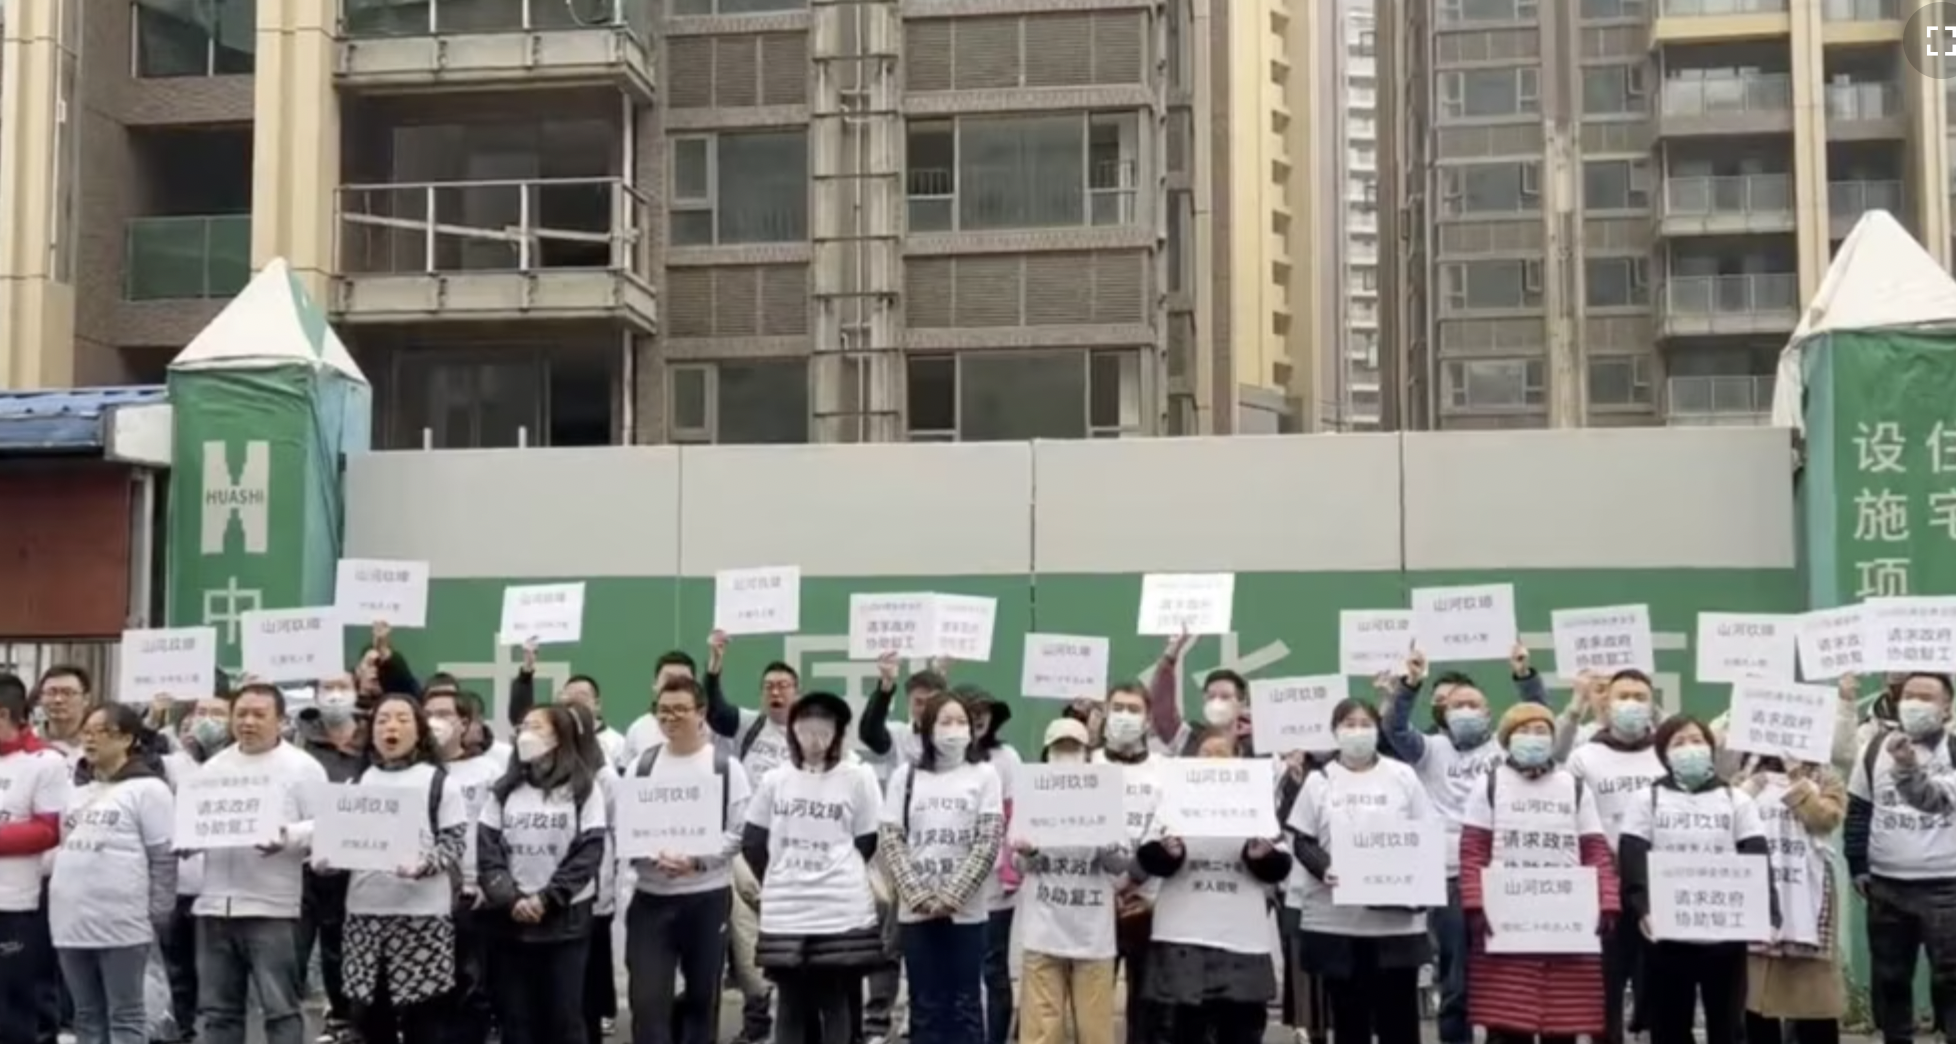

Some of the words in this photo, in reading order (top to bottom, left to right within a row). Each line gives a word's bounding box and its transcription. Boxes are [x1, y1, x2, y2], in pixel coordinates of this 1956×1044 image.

[206, 489, 265, 505] HUASHI
[1433, 595, 1493, 612] 山河玖璋
[261, 617, 321, 634] 山河玖璋
[1357, 618, 1410, 632] 山河玖璋
[1717, 622, 1776, 637] 山河玖璋
[1574, 634, 1631, 651] 请求政府
[1816, 634, 1861, 652] 请求政
[1886, 627, 1952, 642] 请求政府
[1575, 651, 1632, 667] 协助复工
[1820, 651, 1864, 669] 协助复
[1886, 646, 1952, 661] 协助复工
[1270, 686, 1327, 703] 山河玖璋
[1751, 709, 1814, 730] 请求政府
[1749, 727, 1810, 749] 协助复工
[1033, 773, 1099, 791] 山河玖璋
[1186, 768, 1250, 784] 山河玖璋
[637, 786, 700, 803] 山河玖璋
[195, 797, 260, 815] 请求政府
[336, 796, 400, 814] 山河玖璋
[774, 799, 844, 820] 山河玖璋
[1511, 800, 1572, 815] 山河玖璋
[194, 818, 258, 836] 协助复工
[502, 812, 568, 831] 山河玖璋
[1656, 813, 1731, 831] 山河玖璋
[1353, 831, 1420, 849] 山河玖璋
[1503, 830, 1576, 849] 请求政府
[1036, 884, 1105, 907] 协助复工
[1504, 879, 1573, 896] 山河玖璋
[1674, 889, 1745, 906] 请求政府
[1674, 911, 1746, 928] 协助复工
